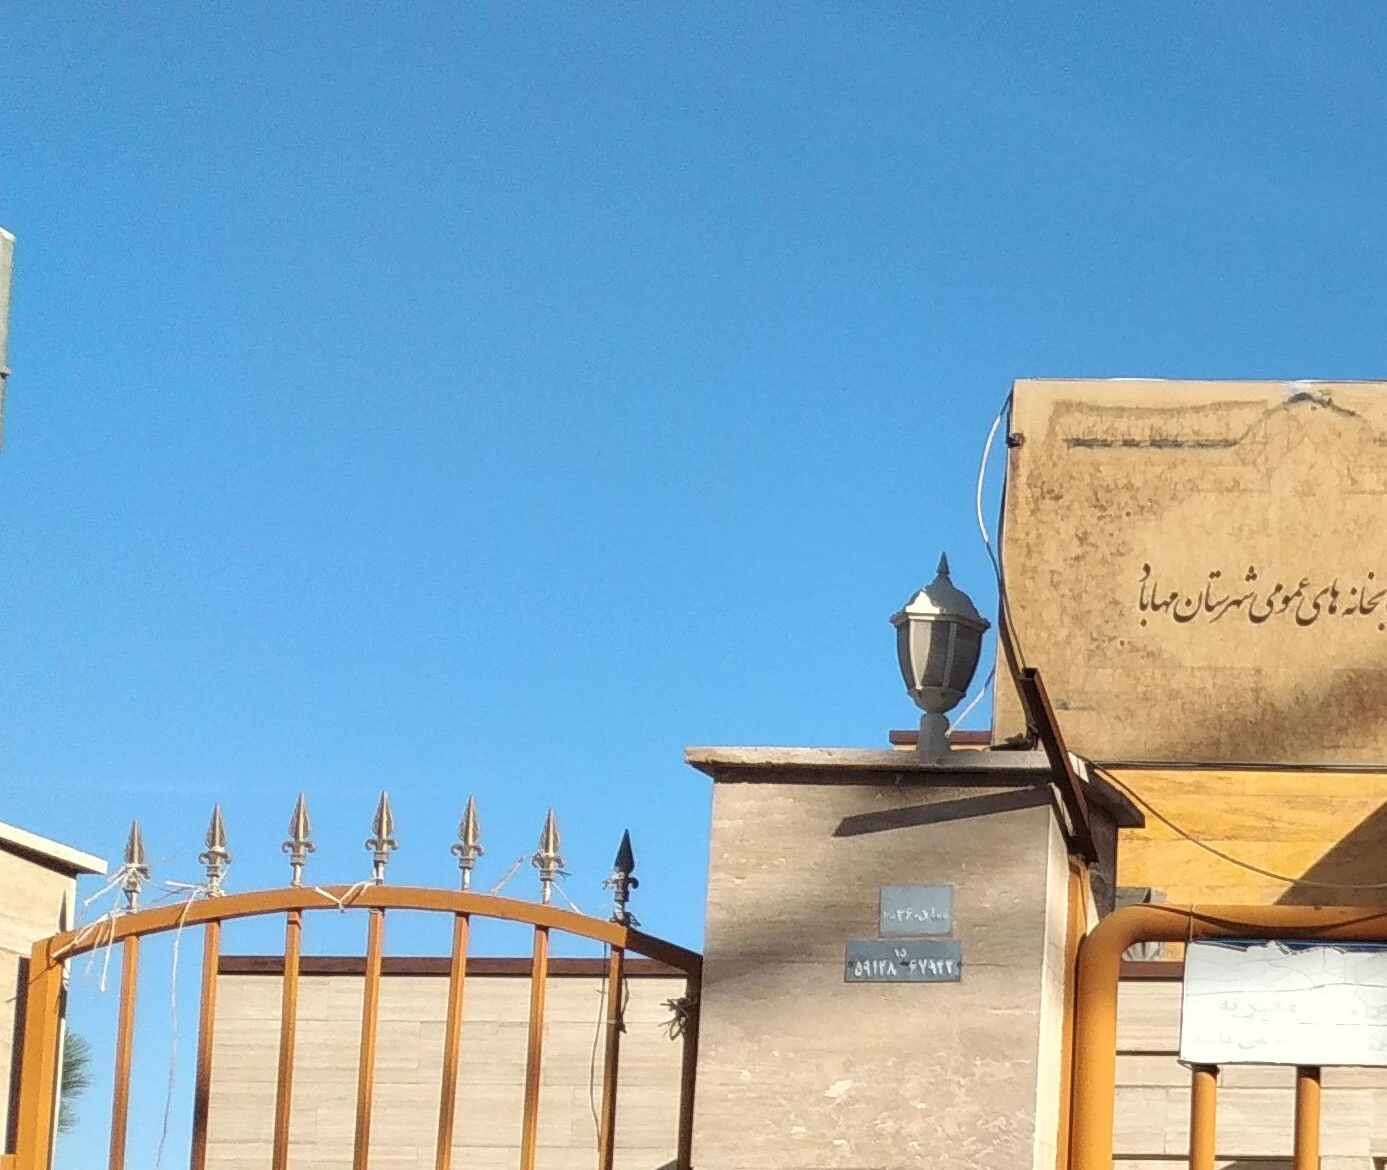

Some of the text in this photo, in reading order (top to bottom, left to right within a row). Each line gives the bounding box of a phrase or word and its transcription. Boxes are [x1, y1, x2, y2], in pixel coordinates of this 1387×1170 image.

[1137, 562, 1179, 627] مهاباد
[1173, 565, 1257, 624] شهرستان
[1247, 576, 1310, 624] عمومی
[1296, 577, 1338, 627] های
